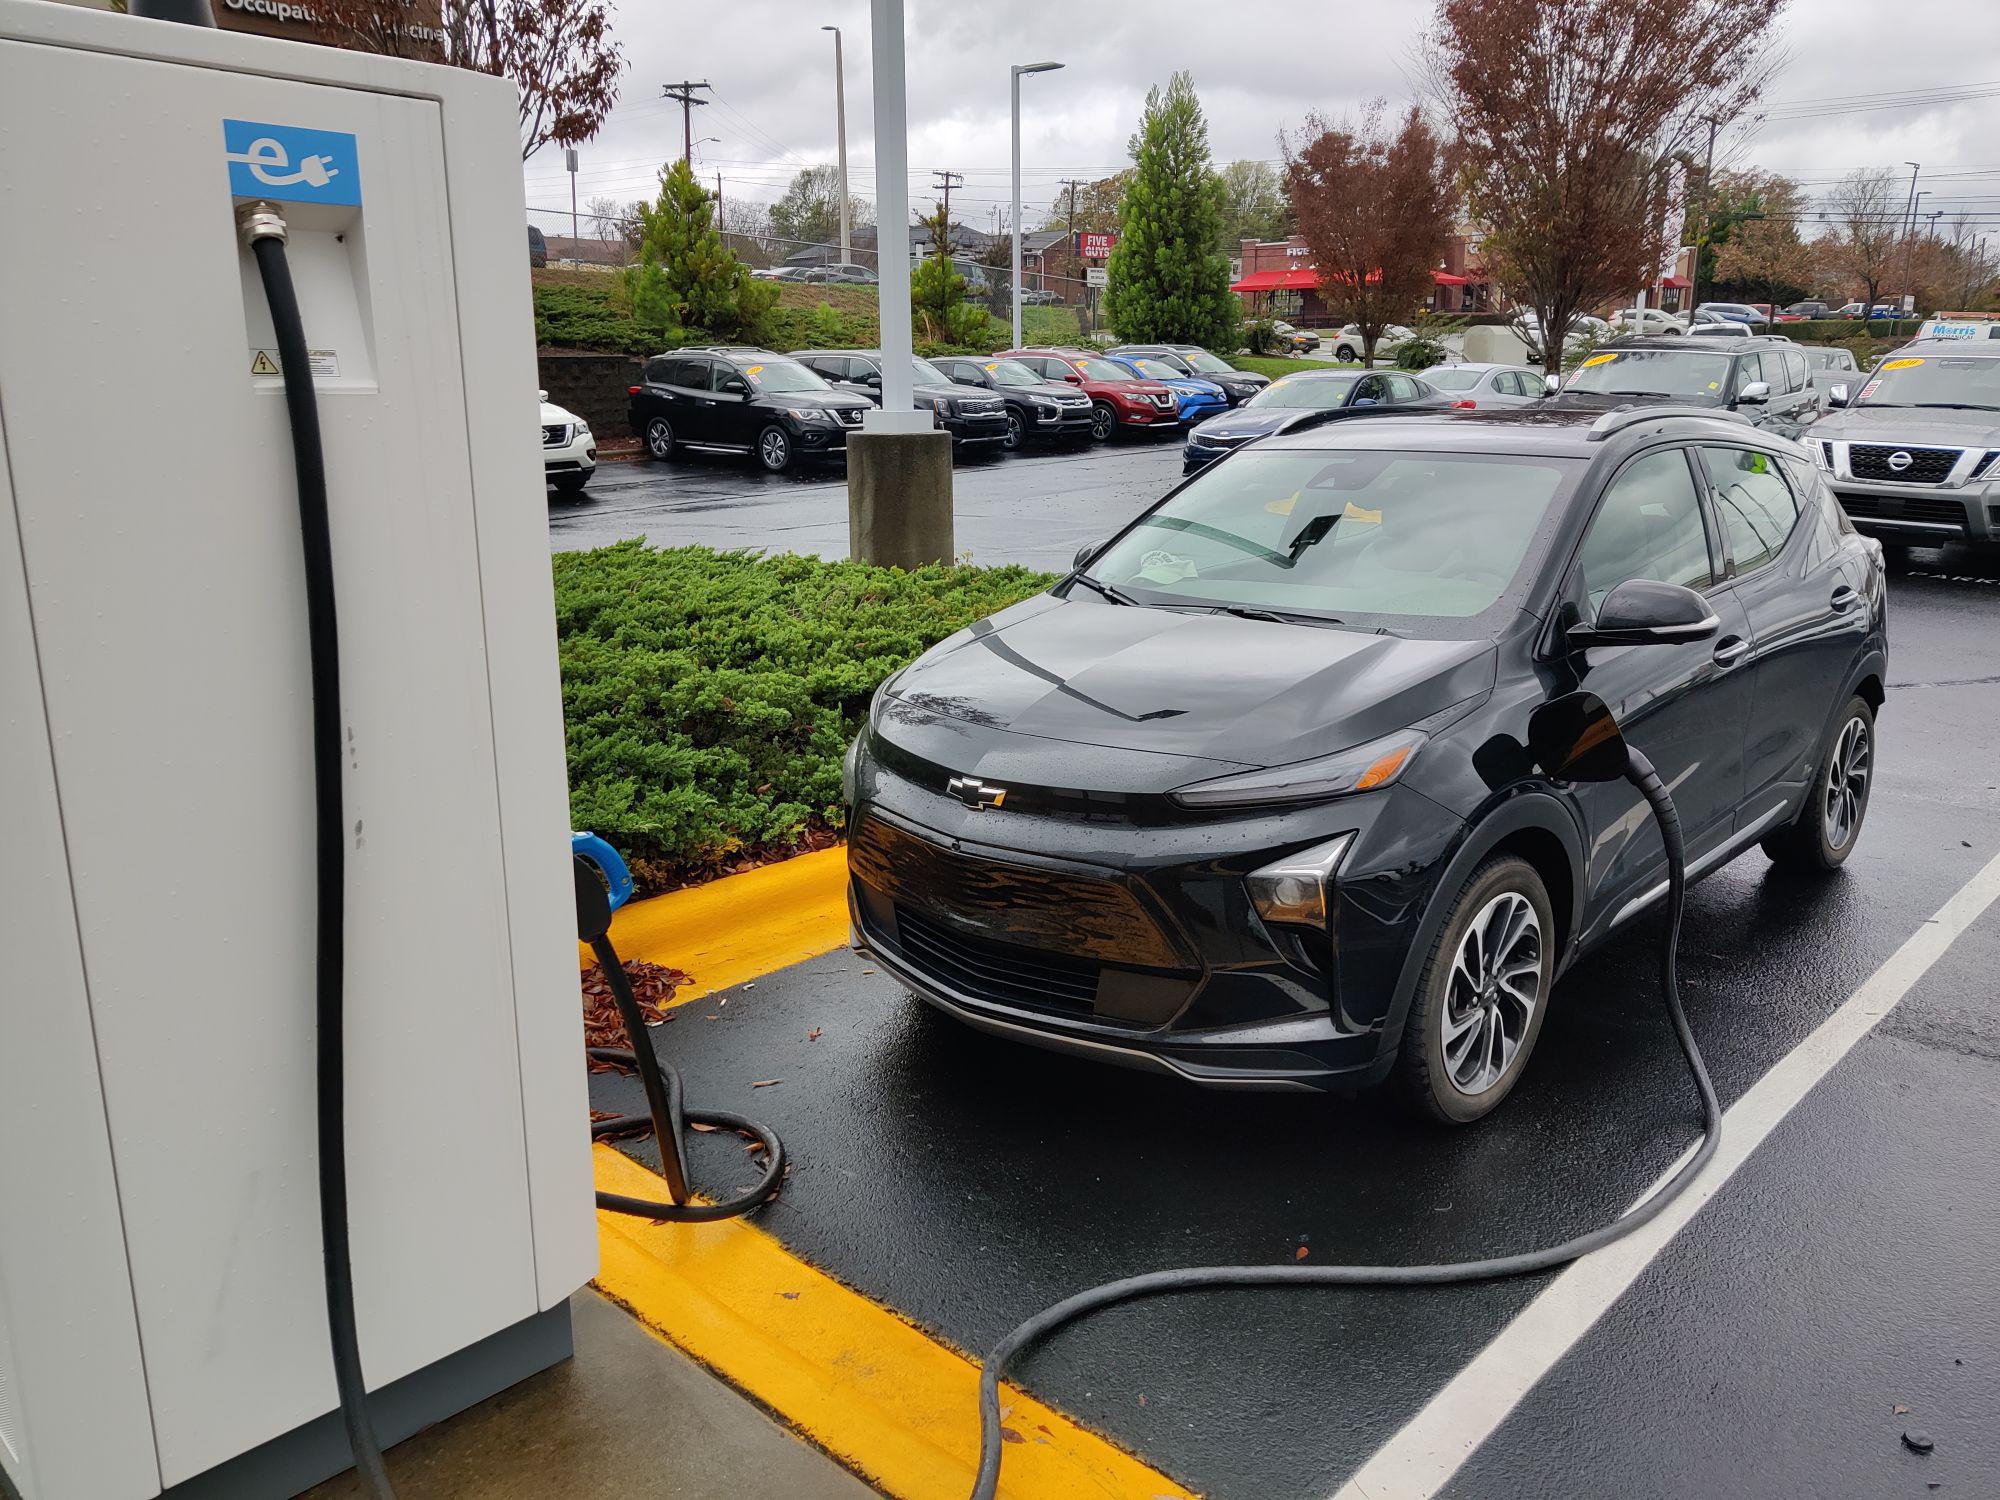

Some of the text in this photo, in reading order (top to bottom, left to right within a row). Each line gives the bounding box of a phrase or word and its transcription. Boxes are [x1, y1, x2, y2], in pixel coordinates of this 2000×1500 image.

[1087, 235, 1108, 246] FIVE
[1085, 246, 1110, 257] GUYS
[1932, 325, 1976, 335] Morris
[1907, 571, 2000, 585] PARK
